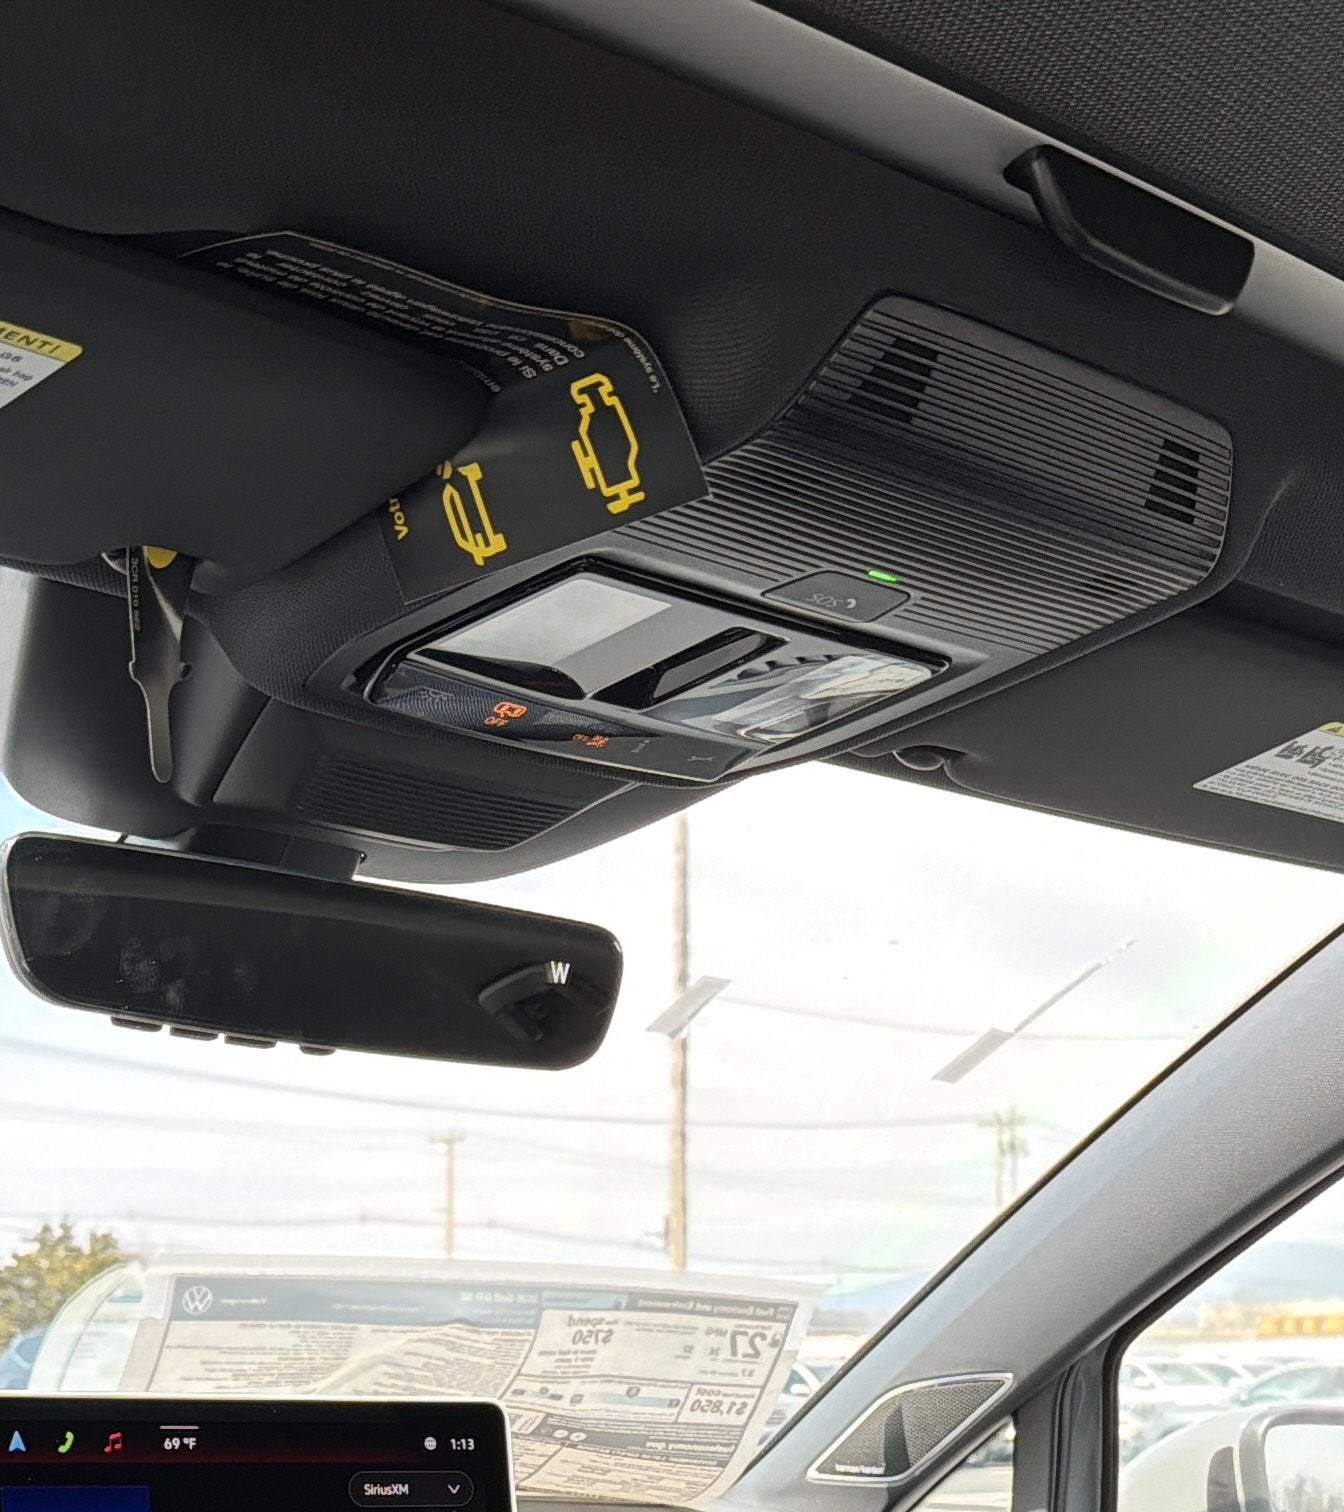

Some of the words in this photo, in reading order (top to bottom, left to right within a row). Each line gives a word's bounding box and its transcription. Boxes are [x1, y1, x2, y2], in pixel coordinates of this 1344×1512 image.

[551, 960, 570, 986] W
[164, 1437, 181, 1450] 69
[450, 1438, 475, 1450] 1:13
[363, 1483, 409, 1496] SiriusXM
